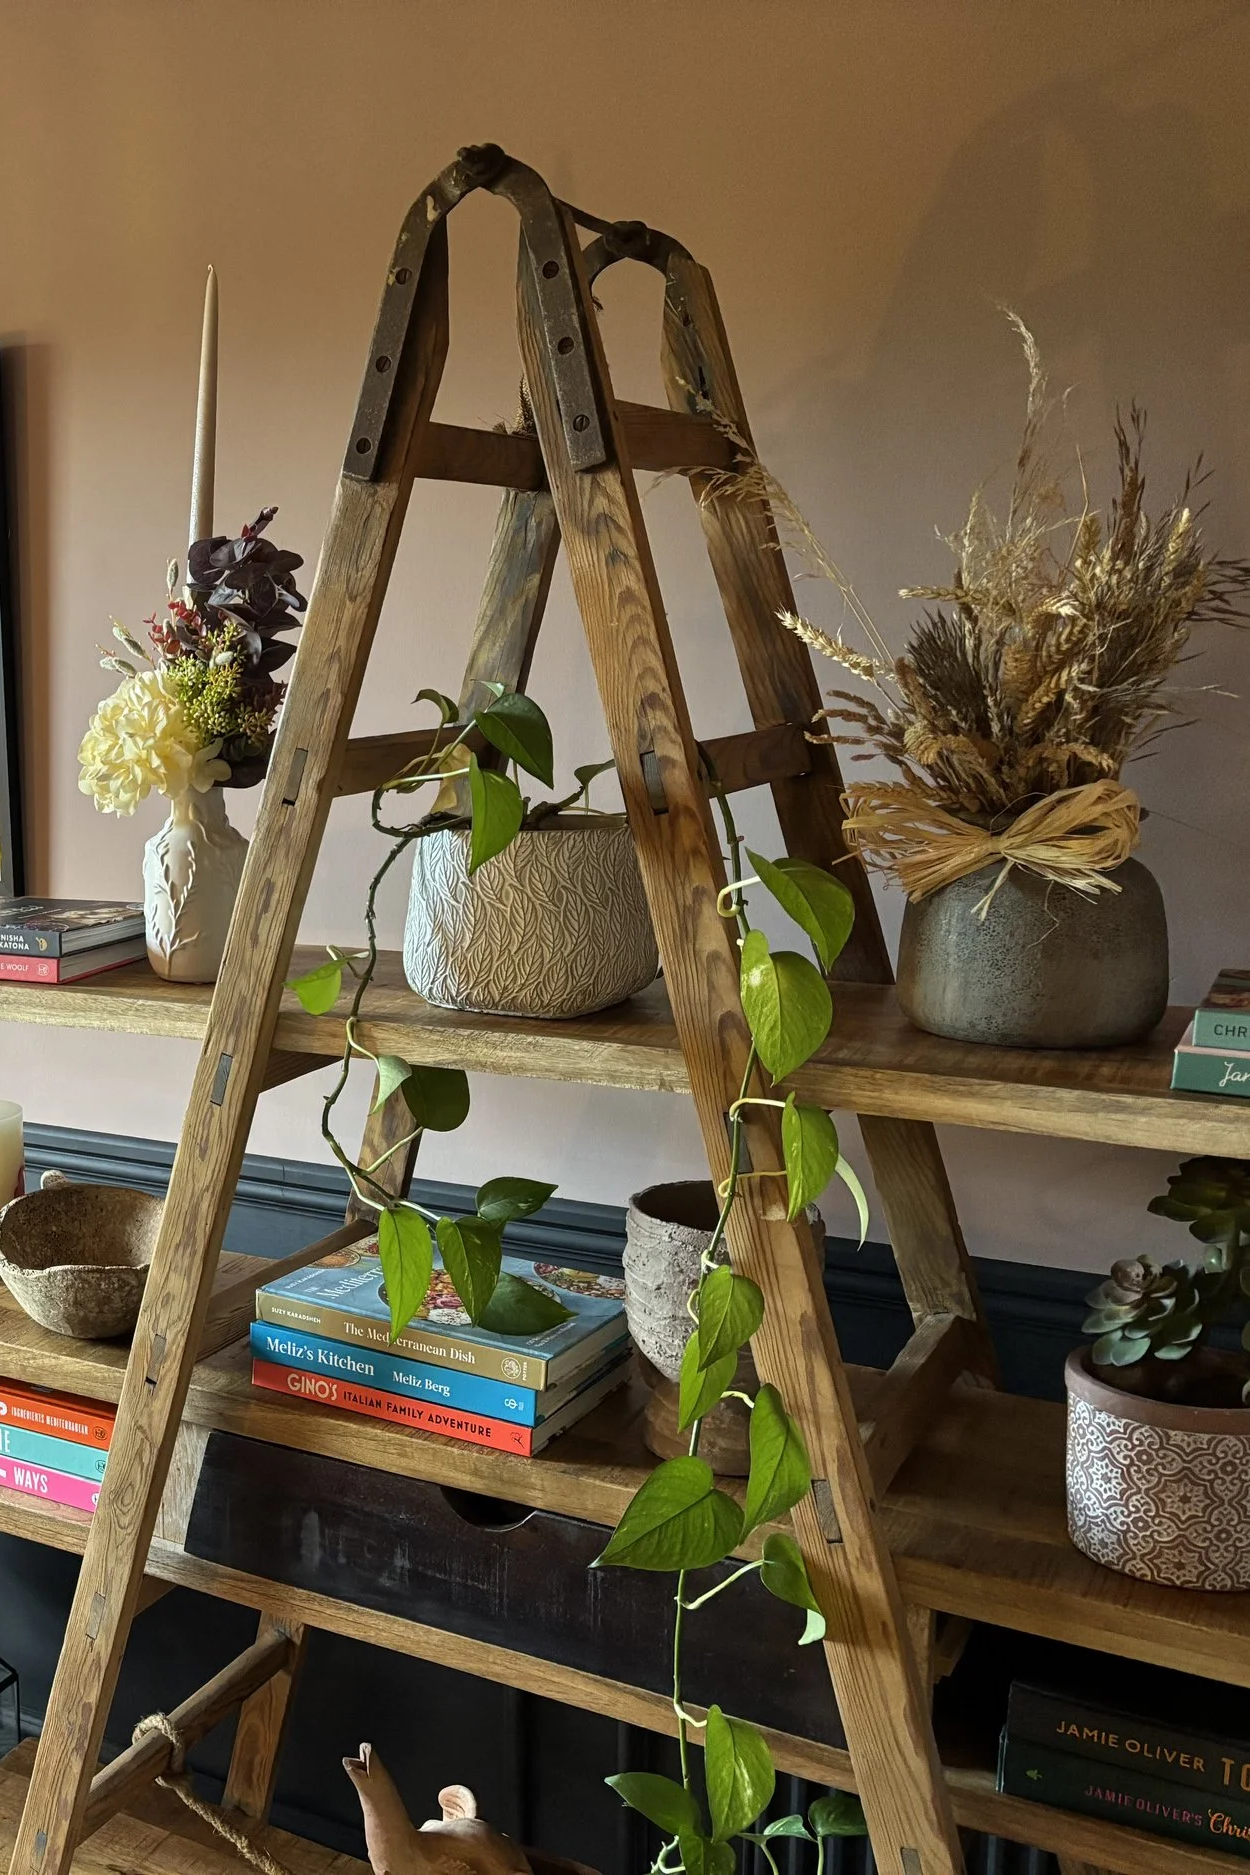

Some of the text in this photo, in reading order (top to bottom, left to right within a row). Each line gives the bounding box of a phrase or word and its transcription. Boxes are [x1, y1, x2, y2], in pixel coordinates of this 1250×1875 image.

[0, 934, 24, 943] NISHA
[6, 963, 29, 971] WOOLF
[271, 1306, 321, 1324] SUZY KARADSHEH
[266, 1336, 375, 1376] Meliz's Kitchen
[343, 1321, 476, 1364] The Mederranean Dish
[392, 1370, 451, 1397] Meliz Berg
[287, 1373, 492, 1438] GINO'S ITALIAN FAMILY ADVENTURE
[11, 1406, 45, 1424] INGREDIENTS
[45, 1415, 89, 1435] MEDITERRANEAN
[13, 1465, 48, 1494] WAYS
[1056, 1720, 1119, 1748] JAMIE
[1125, 1739, 1206, 1772] OLIVER
[1084, 1785, 1134, 1806] JAMIE
[1135, 1798, 1203, 1827] OLIVER'S
